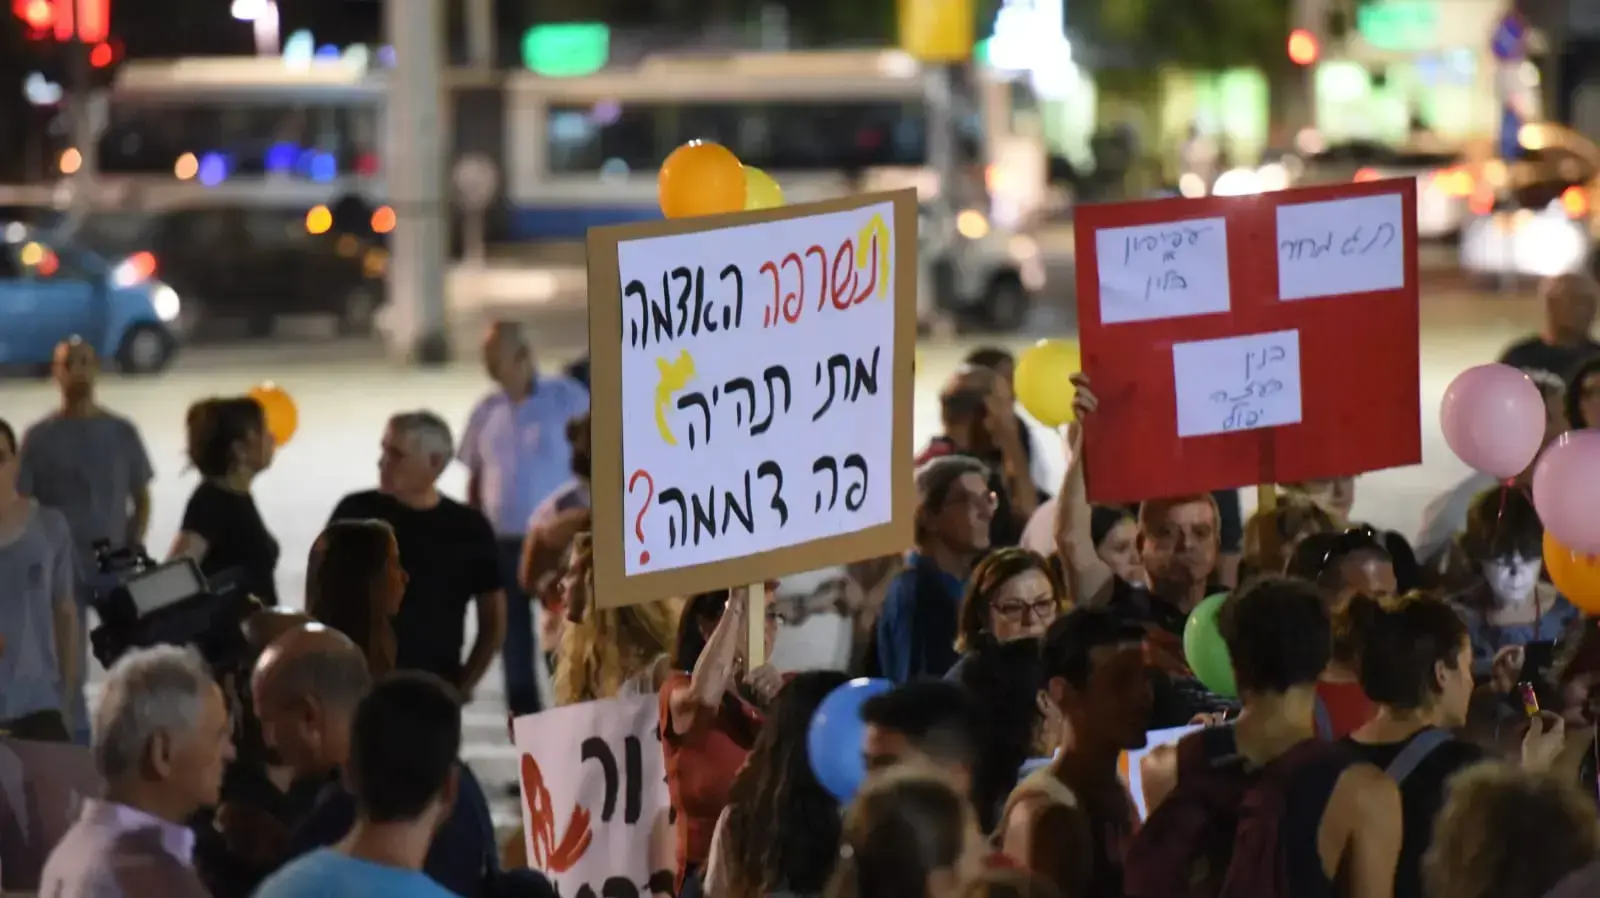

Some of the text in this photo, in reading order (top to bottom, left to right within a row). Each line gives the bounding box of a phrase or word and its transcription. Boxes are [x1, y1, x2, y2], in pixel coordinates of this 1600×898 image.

[1123, 226, 1214, 266] עפיפון
[624, 233, 878, 350] נשרפה האדמה
[1144, 269, 1188, 302] בלון
[676, 346, 881, 451] מתי תהיה
[1245, 346, 1286, 380] בנין
[628, 453, 869, 566] פה דממה?
